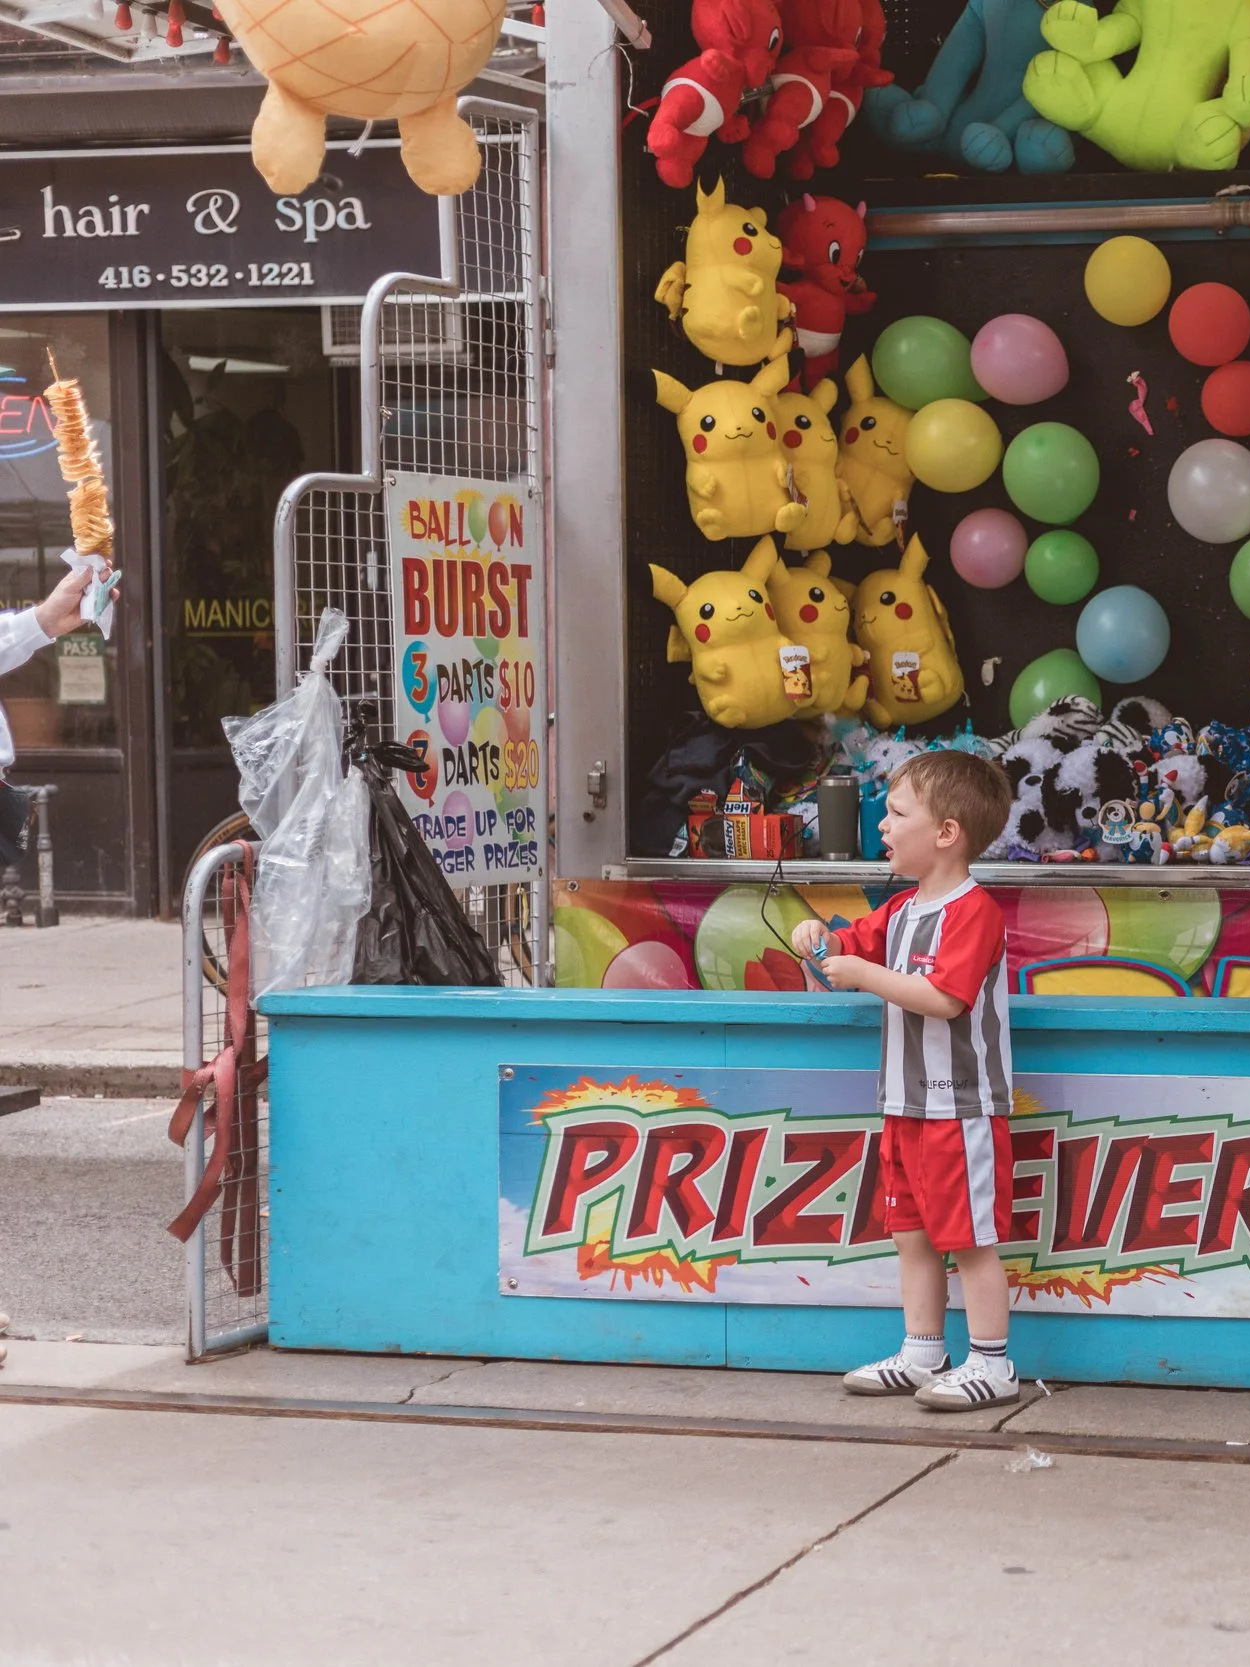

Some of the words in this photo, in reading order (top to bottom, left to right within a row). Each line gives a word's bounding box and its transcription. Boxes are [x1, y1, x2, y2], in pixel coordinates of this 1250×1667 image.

[41, 186, 151, 239] hair
[187, 189, 240, 235] &
[275, 197, 371, 243] spa
[402, 558, 533, 638] BURST
[63, 641, 97, 656] PASS
[411, 653, 429, 702] 3
[437, 658, 494, 703] DARTS
[499, 659, 535, 711] $10
[442, 741, 500, 787] DARTS
[504, 739, 540, 792] $20
[475, 809, 497, 836] UP
[506, 807, 535, 835] FOR
[725, 803, 749, 812] Heft
[725, 821, 734, 854] Hefty
[432, 845, 475, 873] RGER
[483, 841, 538, 870] PRIZES
